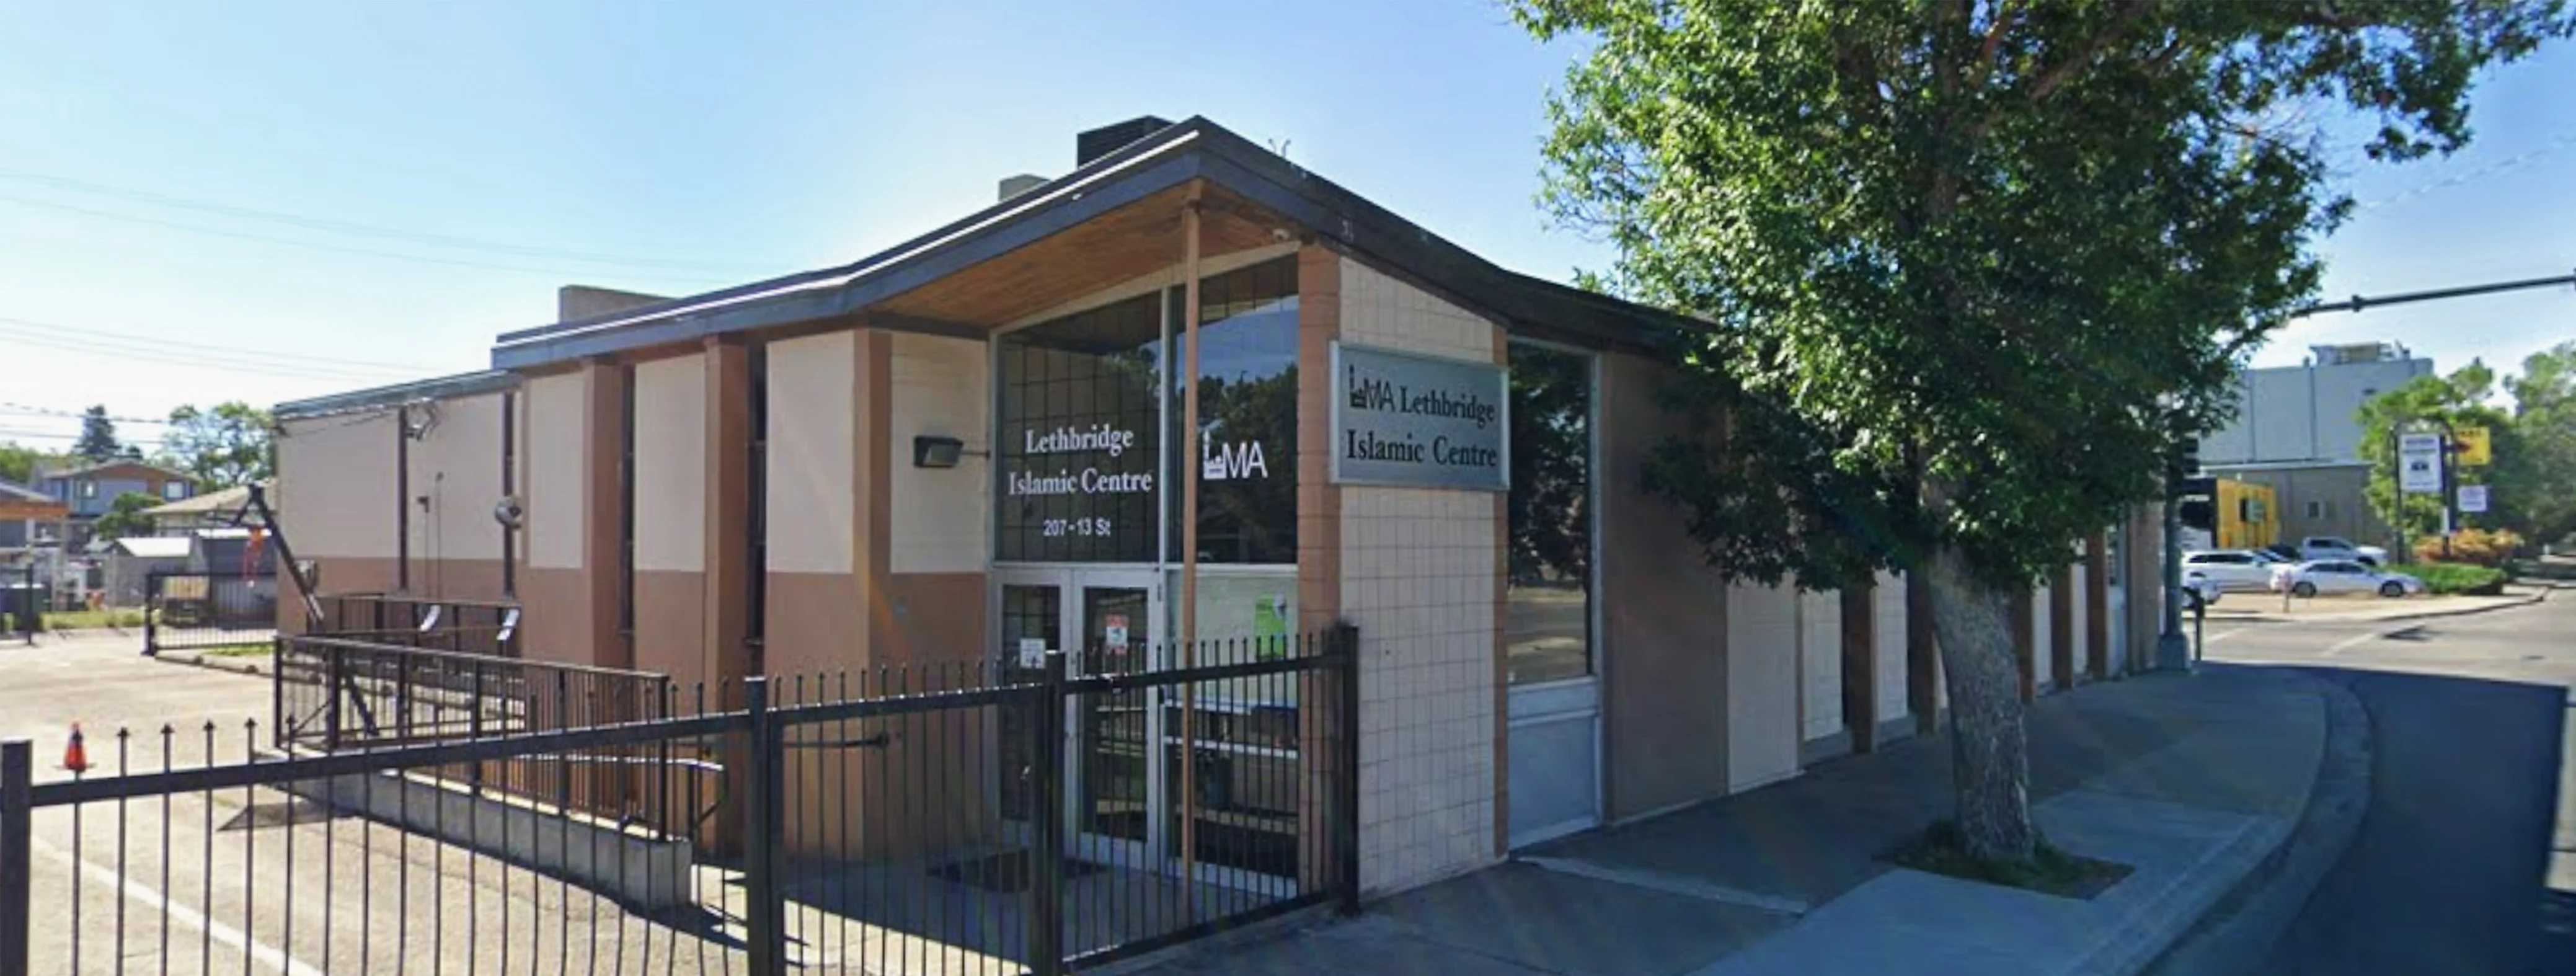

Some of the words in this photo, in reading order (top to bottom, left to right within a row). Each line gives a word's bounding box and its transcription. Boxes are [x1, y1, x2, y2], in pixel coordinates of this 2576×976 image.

[1400, 386, 1495, 428] Lethbridge
[1026, 424, 1134, 456] Lethbridge
[1347, 429, 1425, 463] Islamic
[1433, 435, 1497, 466] Centre
[1009, 468, 1078, 495] Islamic
[1081, 466, 1153, 494] Centre
[1095, 517, 1111, 537] St
